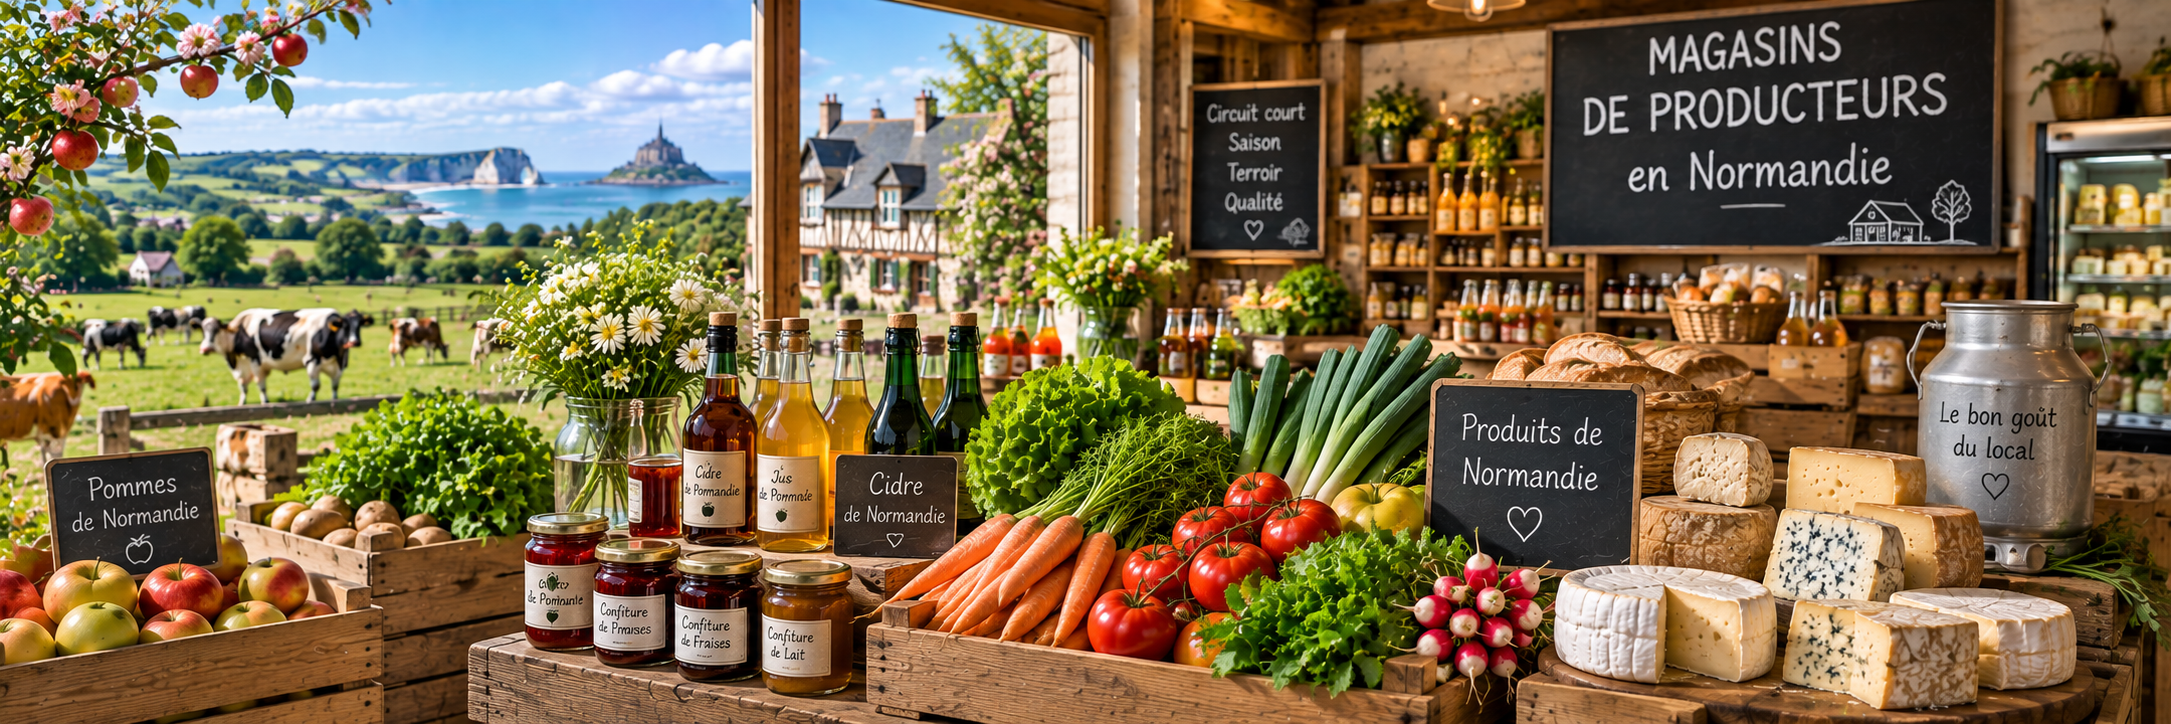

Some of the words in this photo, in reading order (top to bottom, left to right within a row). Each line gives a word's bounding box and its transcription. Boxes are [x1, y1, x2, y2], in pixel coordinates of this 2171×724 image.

[1649, 21, 1842, 76] MAGASINS
[1206, 103, 1259, 123] Circuit
[1264, 102, 1306, 121] court
[1583, 94, 1630, 136] DE
[1650, 72, 1949, 133] PRODUCTEURS
[1228, 132, 1282, 152] Saison
[1227, 162, 1283, 182] Terroir
[1627, 164, 1670, 193] en
[1689, 141, 1893, 191] Normandie
[1224, 191, 1284, 214] Qualité
[1940, 401, 1960, 423] Le
[1968, 403, 2003, 426] bon
[1462, 413, 1561, 444] Produits
[1574, 416, 1603, 446] de
[1953, 434, 1977, 457] du
[1986, 436, 2035, 460] local
[695, 464, 722, 480] Cidre
[1462, 456, 1599, 491] Normandie
[87, 476, 177, 501] Pommes
[869, 471, 924, 496] Cidre
[72, 511, 95, 533] de
[103, 500, 200, 530] Normandie
[843, 505, 861, 522] de
[866, 505, 946, 524] Normandie
[600, 602, 649, 621] Confiture
[598, 620, 608, 633] de
[681, 615, 731, 634] Confiture
[680, 633, 691, 648] de
[693, 635, 731, 650] Fraises
[767, 626, 814, 646] Confiture
[770, 646, 781, 659] de
[784, 647, 806, 661] Lait
